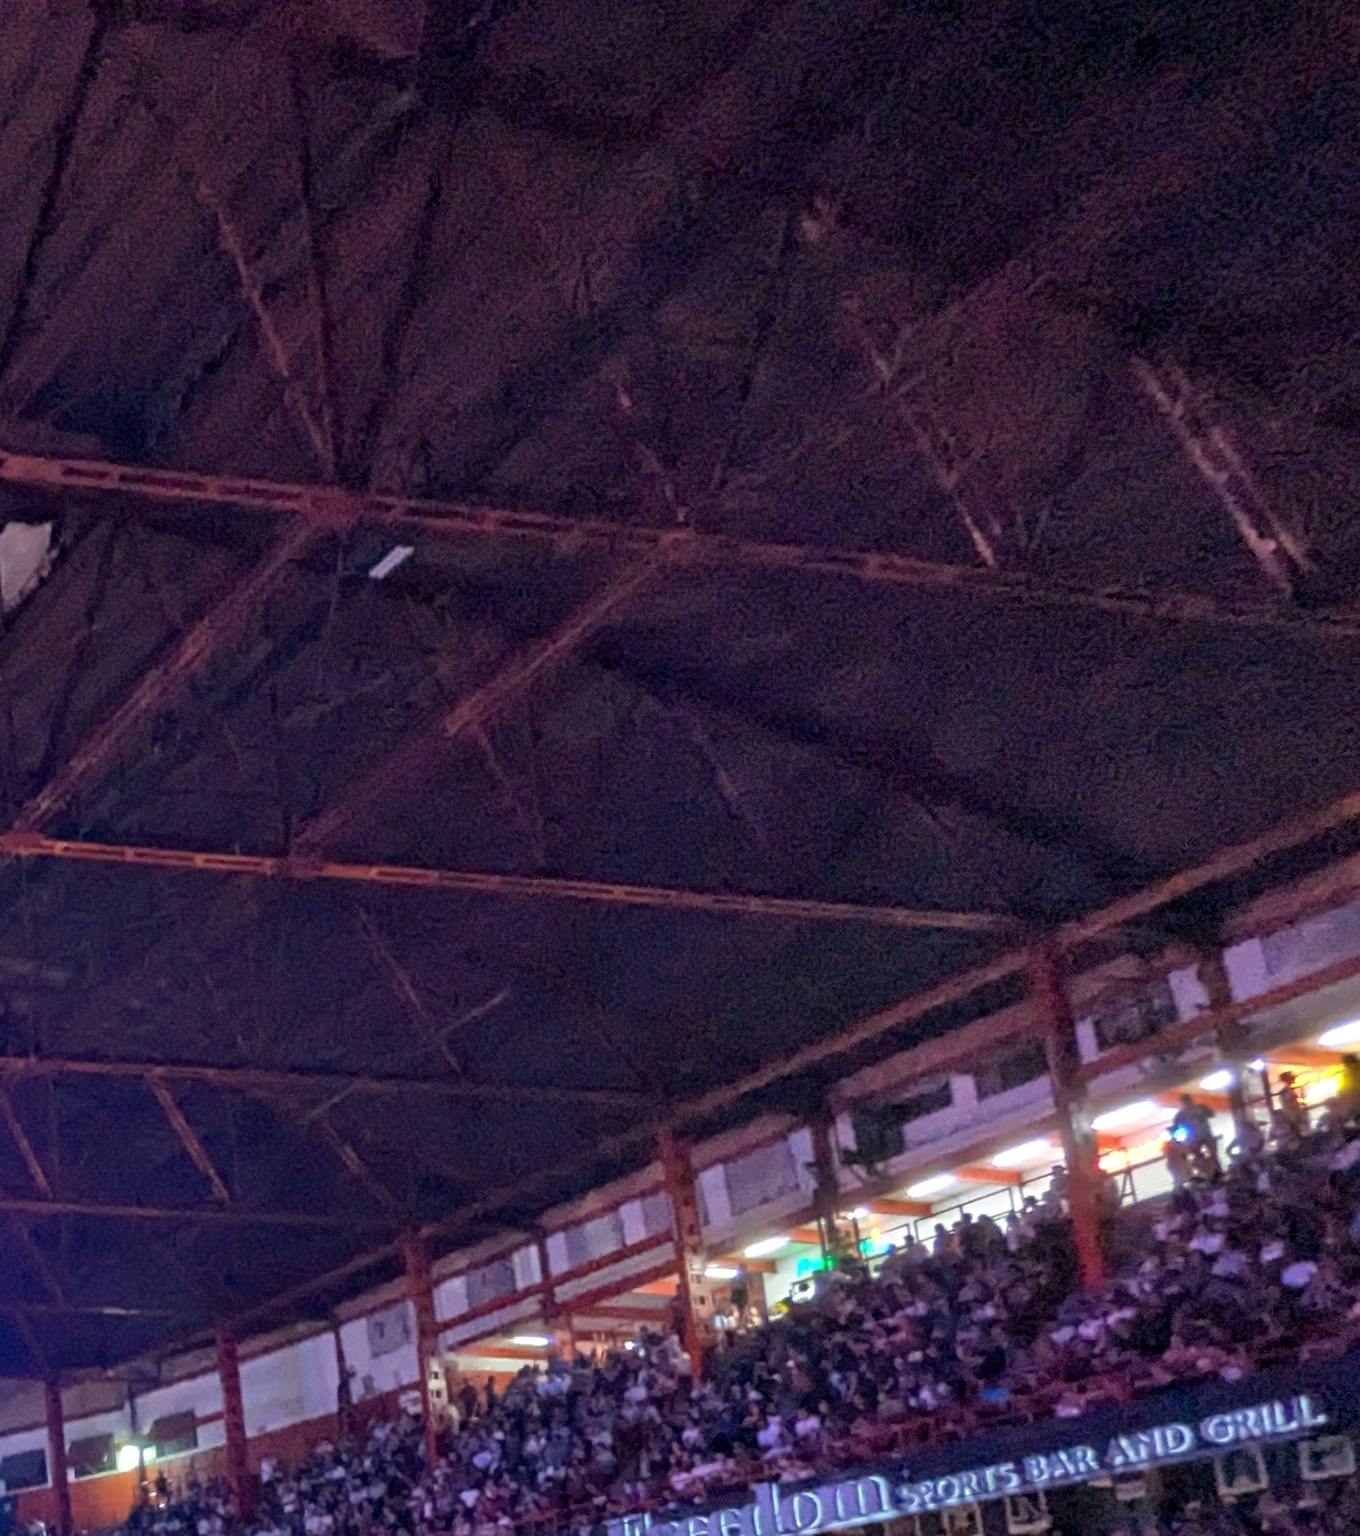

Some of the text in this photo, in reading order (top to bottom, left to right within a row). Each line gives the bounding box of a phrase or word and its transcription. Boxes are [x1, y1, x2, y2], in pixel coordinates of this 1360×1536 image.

[896, 1462, 1021, 1509] SPORTS
[1023, 1445, 1100, 1483] BAR
[1107, 1423, 1193, 1466] AND
[1199, 1395, 1327, 1445] GRILL
